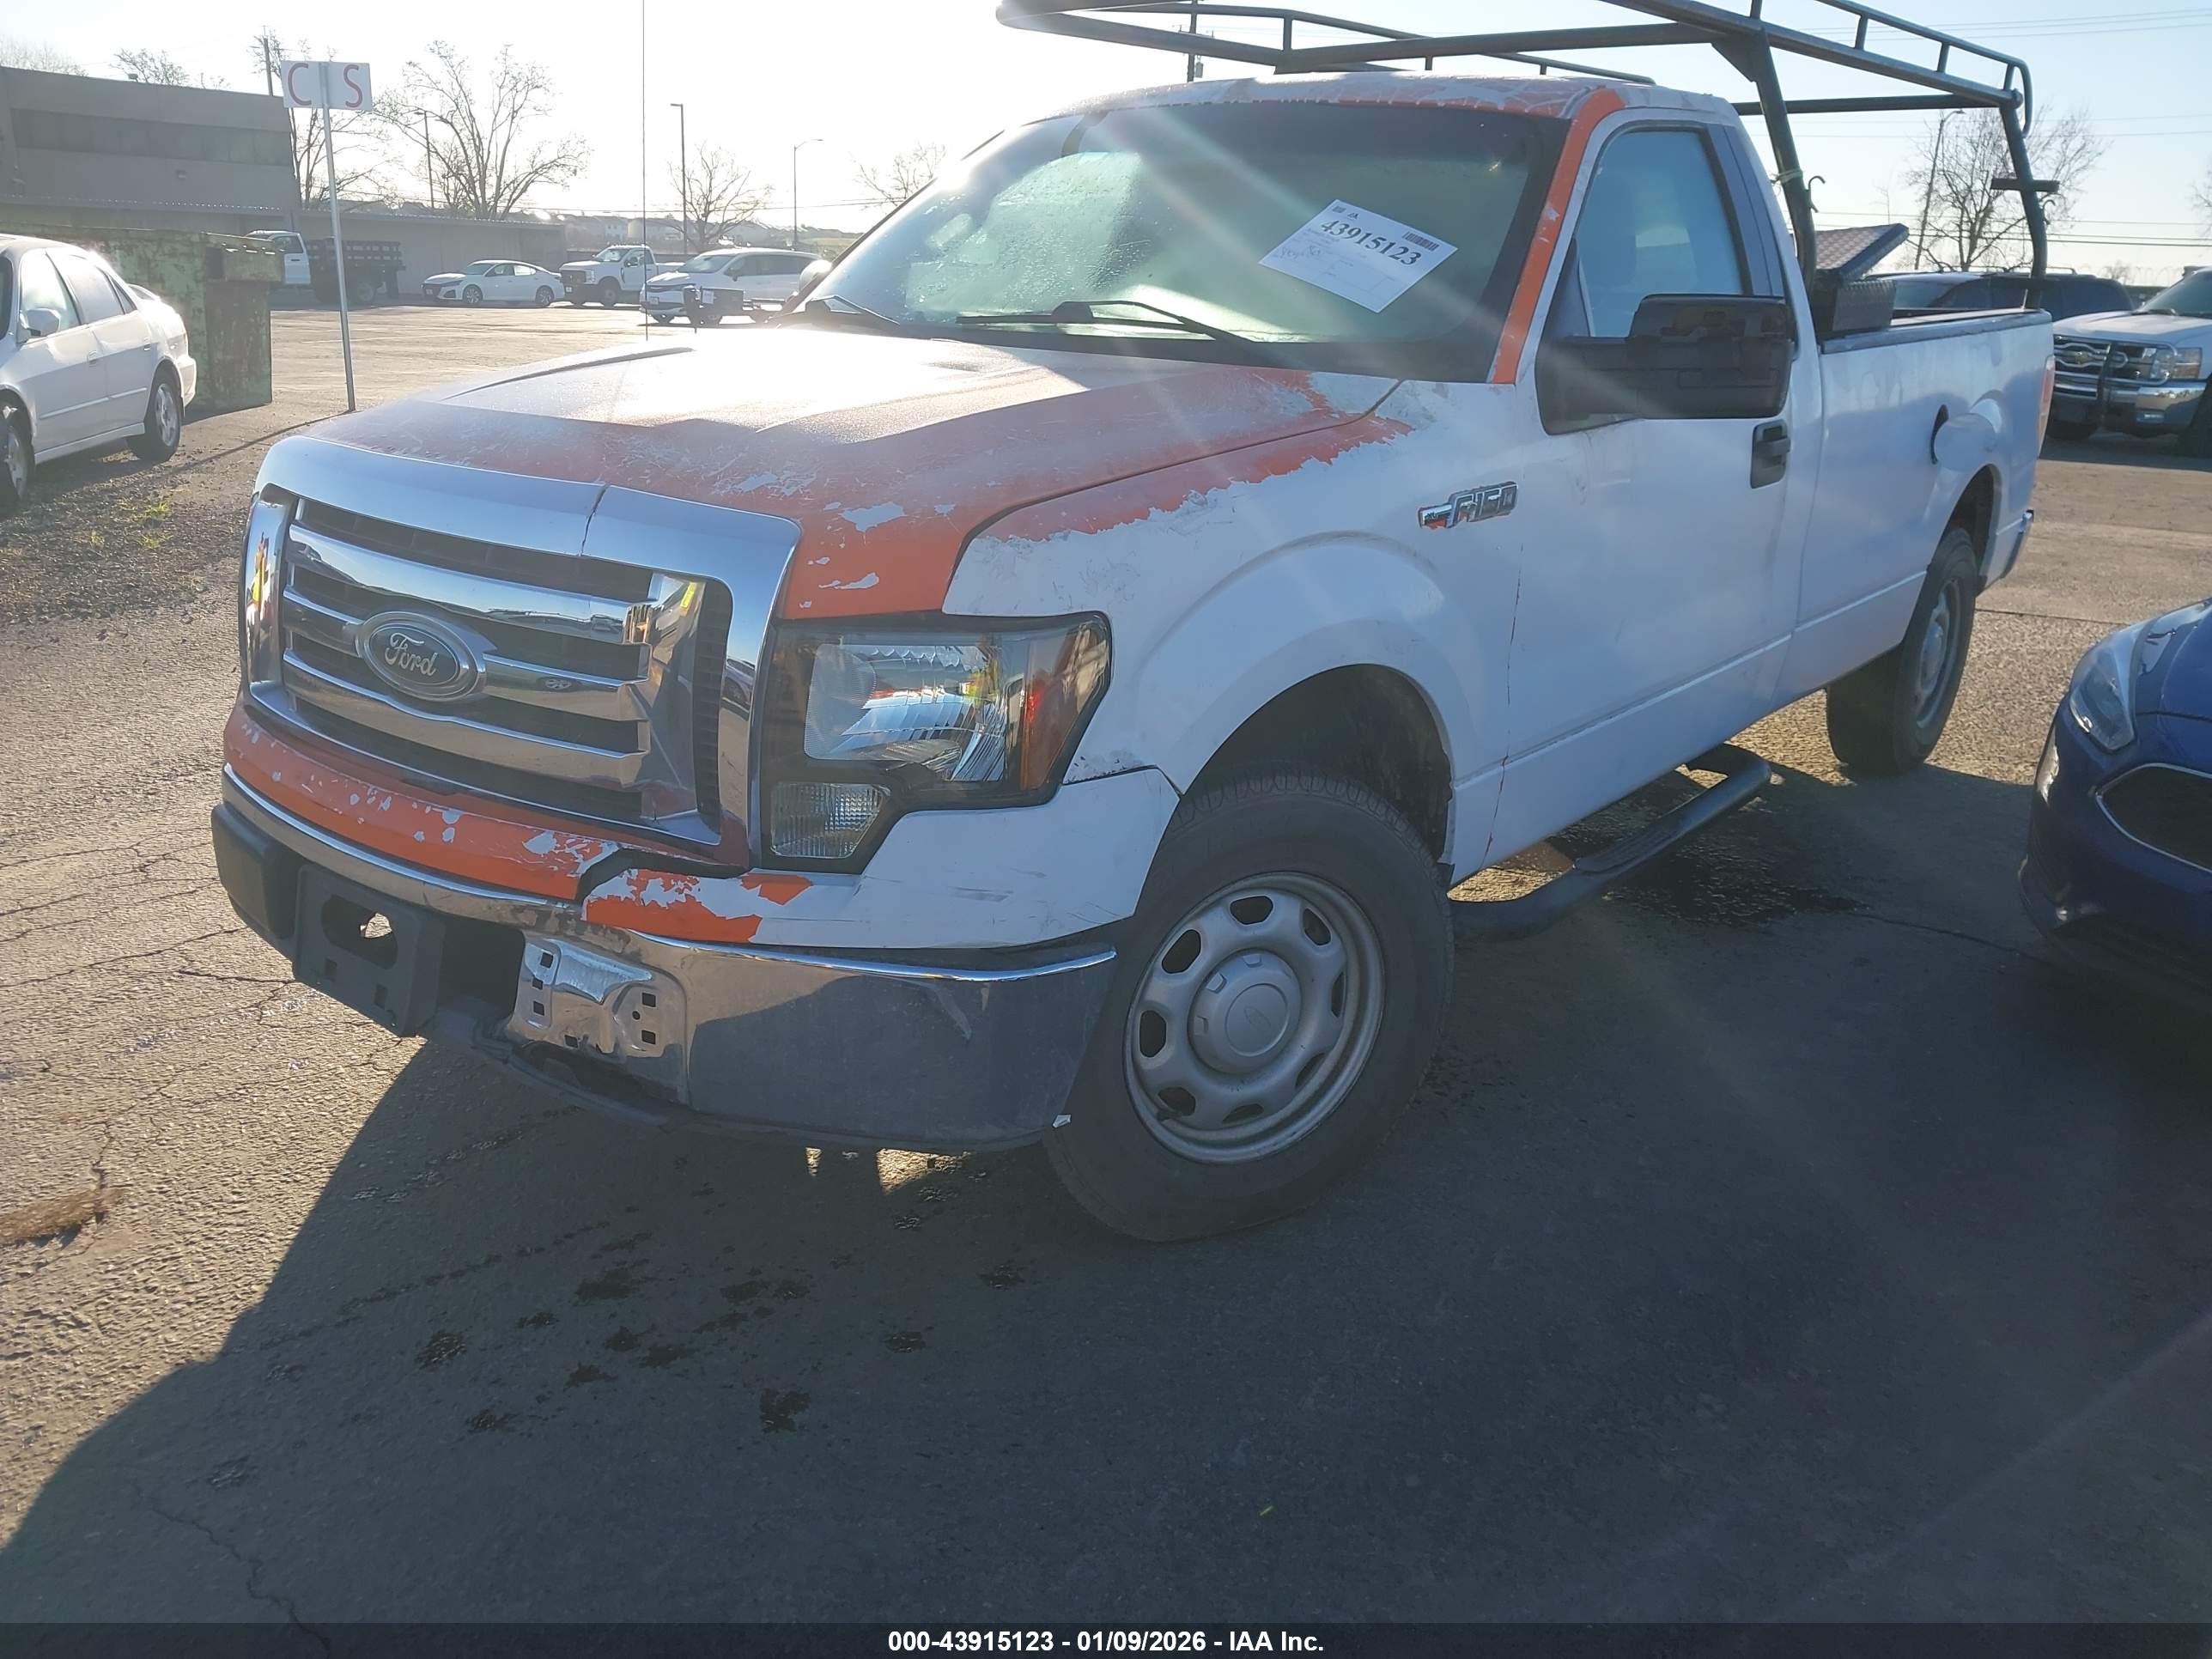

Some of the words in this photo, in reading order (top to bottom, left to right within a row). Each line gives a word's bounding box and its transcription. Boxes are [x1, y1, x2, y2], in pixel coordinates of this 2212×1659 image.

[288, 63, 312, 106] C
[343, 64, 362, 108] S
[1321, 219, 1422, 266] 43915123
[384, 632, 438, 677] Ford
